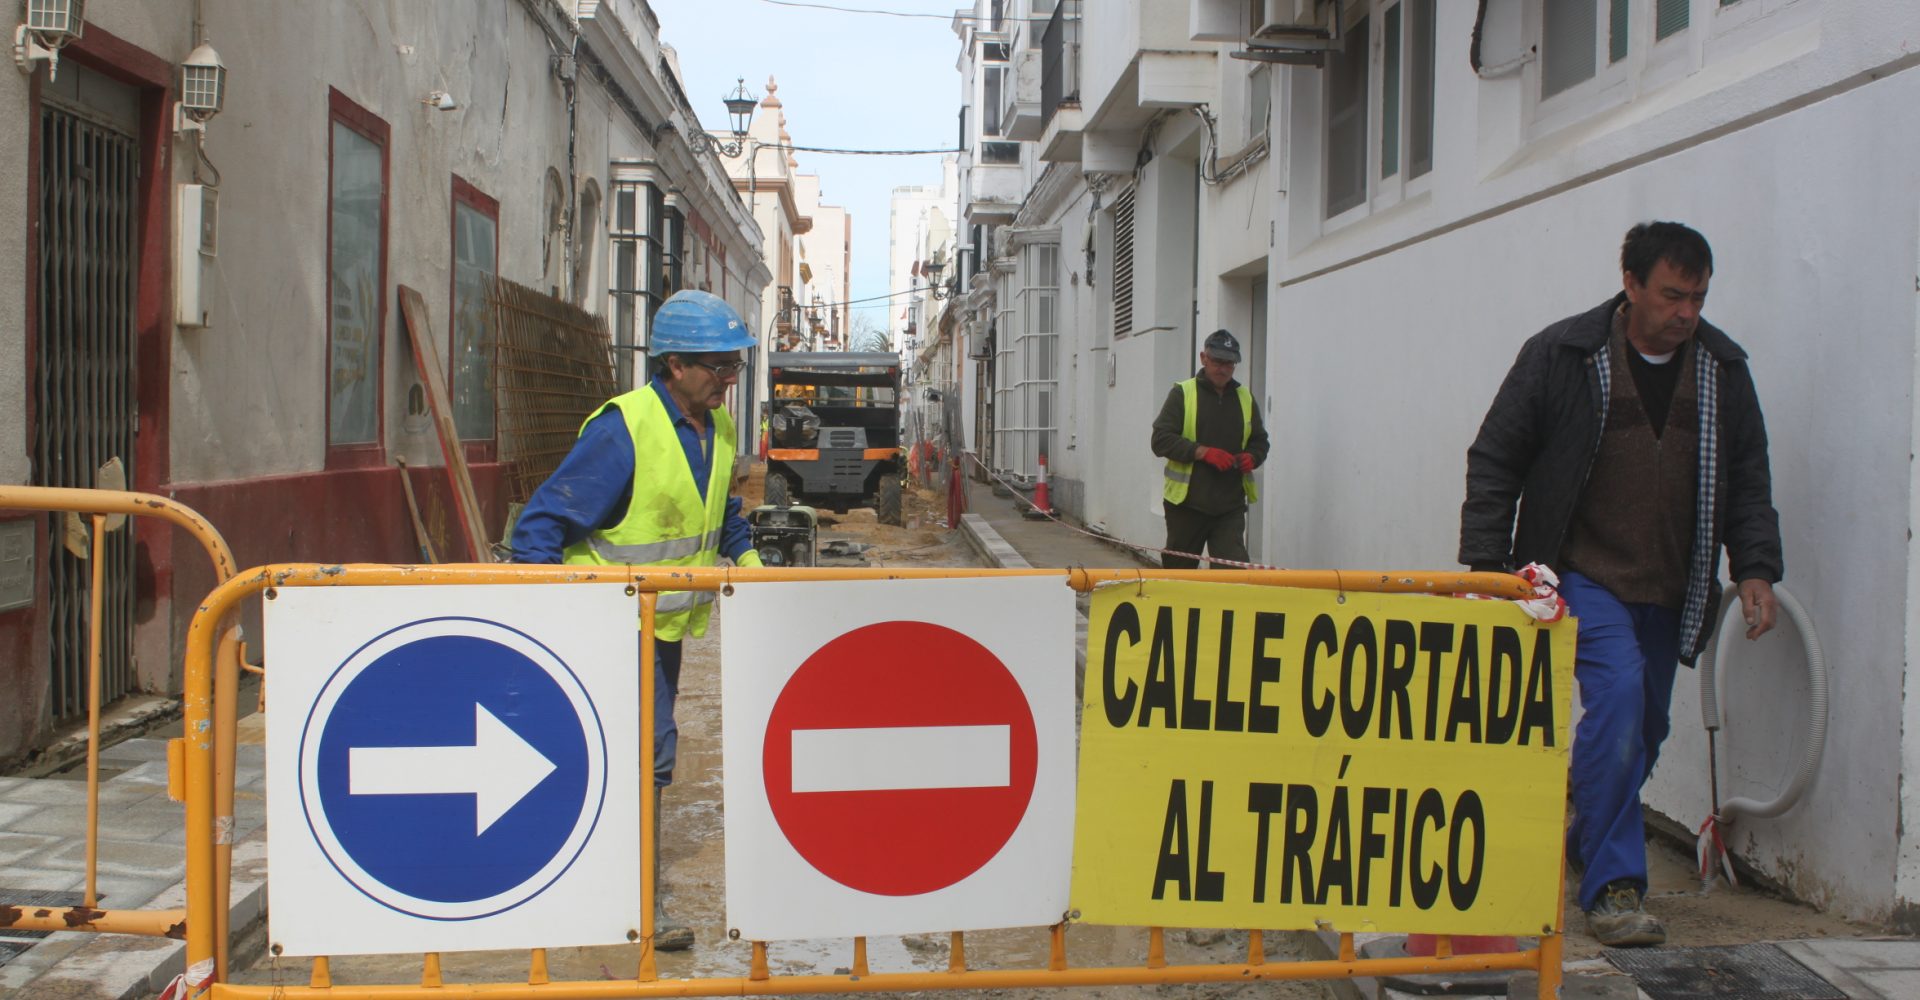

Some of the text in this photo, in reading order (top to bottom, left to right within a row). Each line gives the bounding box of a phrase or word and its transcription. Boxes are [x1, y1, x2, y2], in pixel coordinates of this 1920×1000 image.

[1103, 602, 1556, 747] CALLE CORTADA
[1152, 755, 1486, 911] AL TRÁFICO
